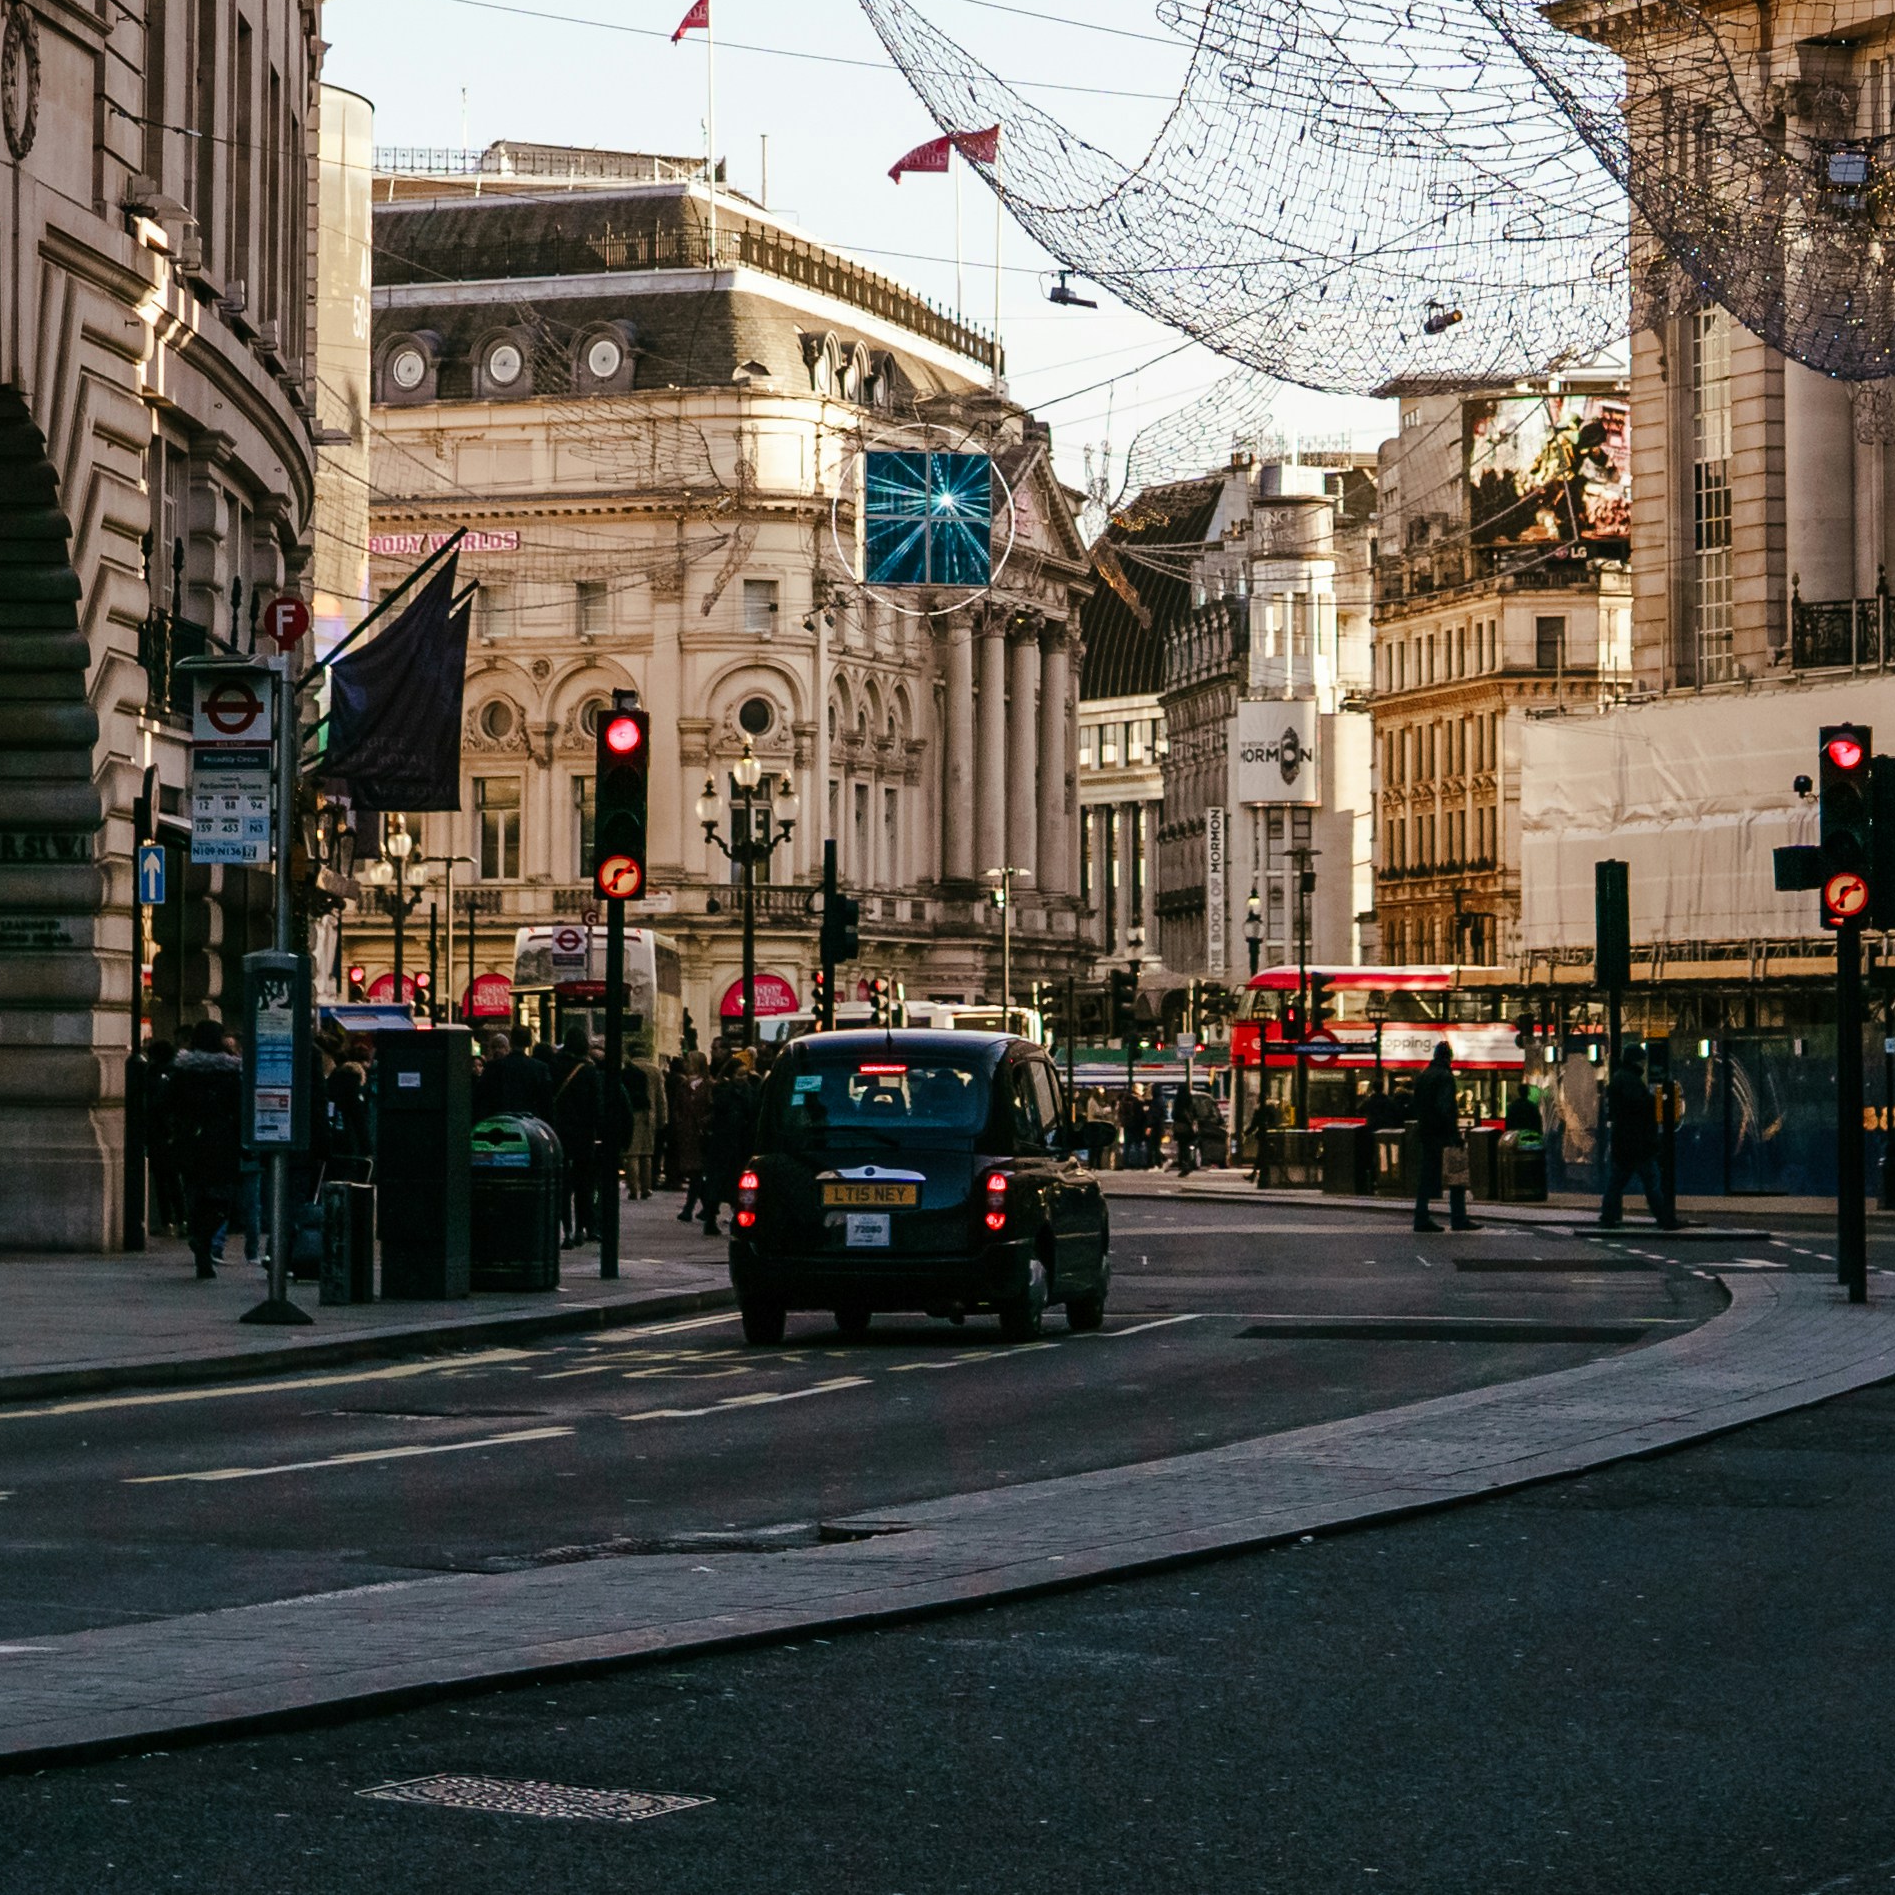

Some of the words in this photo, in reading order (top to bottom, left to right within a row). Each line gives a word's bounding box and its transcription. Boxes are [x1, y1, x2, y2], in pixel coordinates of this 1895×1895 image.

[369, 536, 421, 554] BODY
[429, 532, 519, 553] WRLDS
[1571, 546, 1587, 558] LG
[275, 604, 296, 636] F
[199, 801, 209, 810] 12
[225, 801, 236, 810] 88
[251, 801, 263, 810] 94
[196, 824, 212, 833] 159
[1211, 809, 1221, 874] MORMON
[1211, 877, 1221, 897] OF
[585, 912, 597, 924] G
[1211, 902, 1222, 944] BOOK
[874, 1187, 906, 1202] NEY
